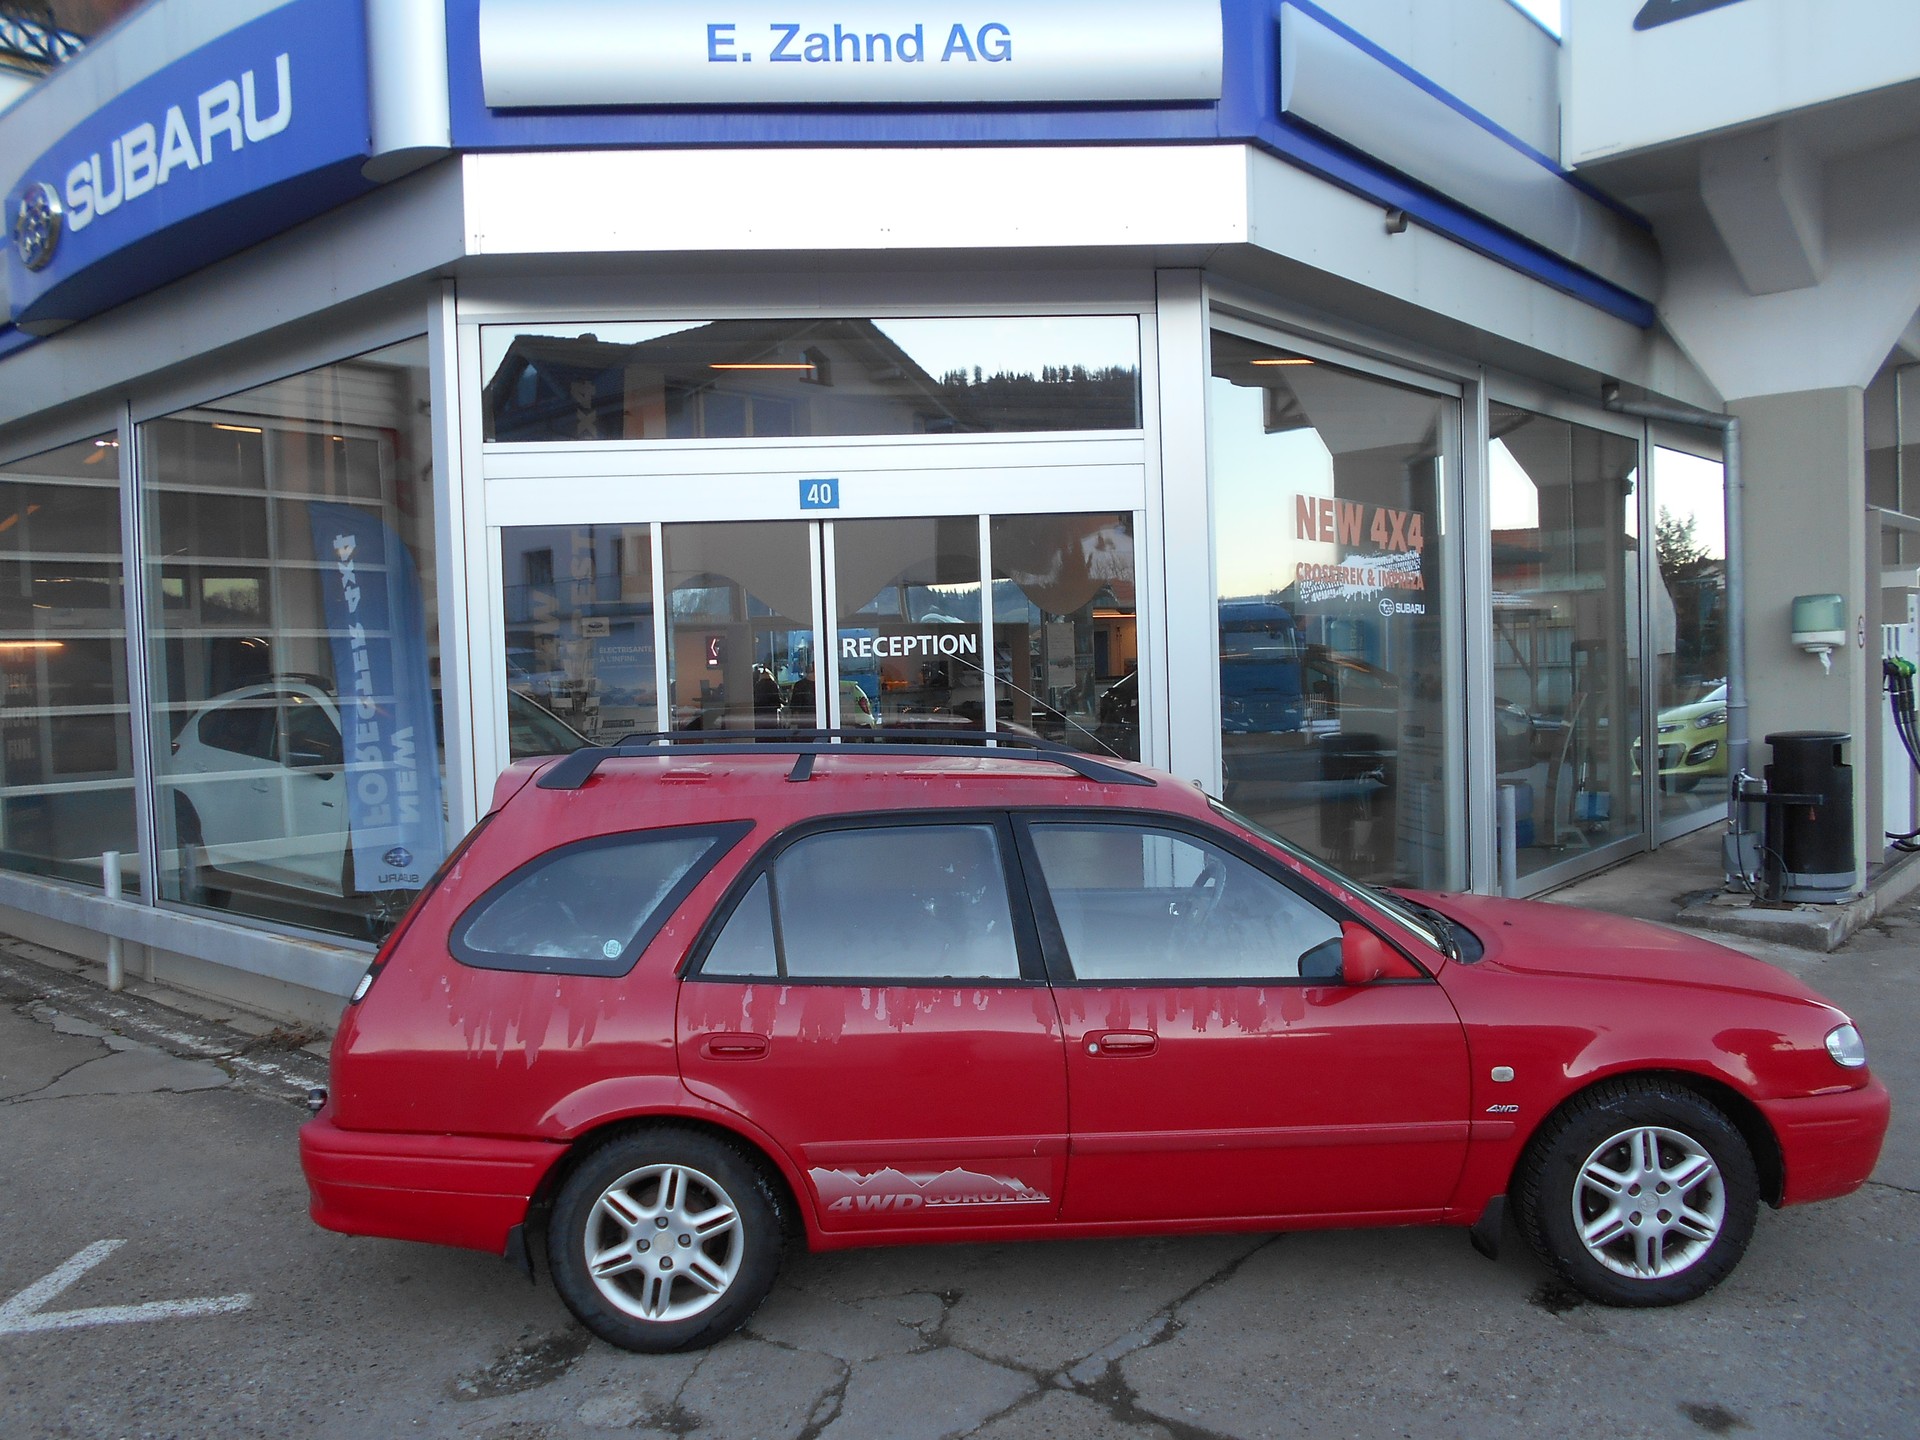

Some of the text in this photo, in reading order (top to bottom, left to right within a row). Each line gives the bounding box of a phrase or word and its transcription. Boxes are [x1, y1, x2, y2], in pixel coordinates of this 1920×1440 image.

[707, 22, 1012, 62] E. Zahnd AG
[65, 52, 293, 232] SUBARU
[807, 483, 832, 504] 40
[1296, 494, 1424, 554] NEW 4X4
[1296, 562, 1425, 590] CROSSTREK & IMPREZA
[1395, 604, 1425, 615] SUBARU
[842, 633, 977, 658] RECEPTION
[1486, 1104, 1520, 1113] 4WD
[827, 1190, 1049, 1213] 4WD COROLLA
